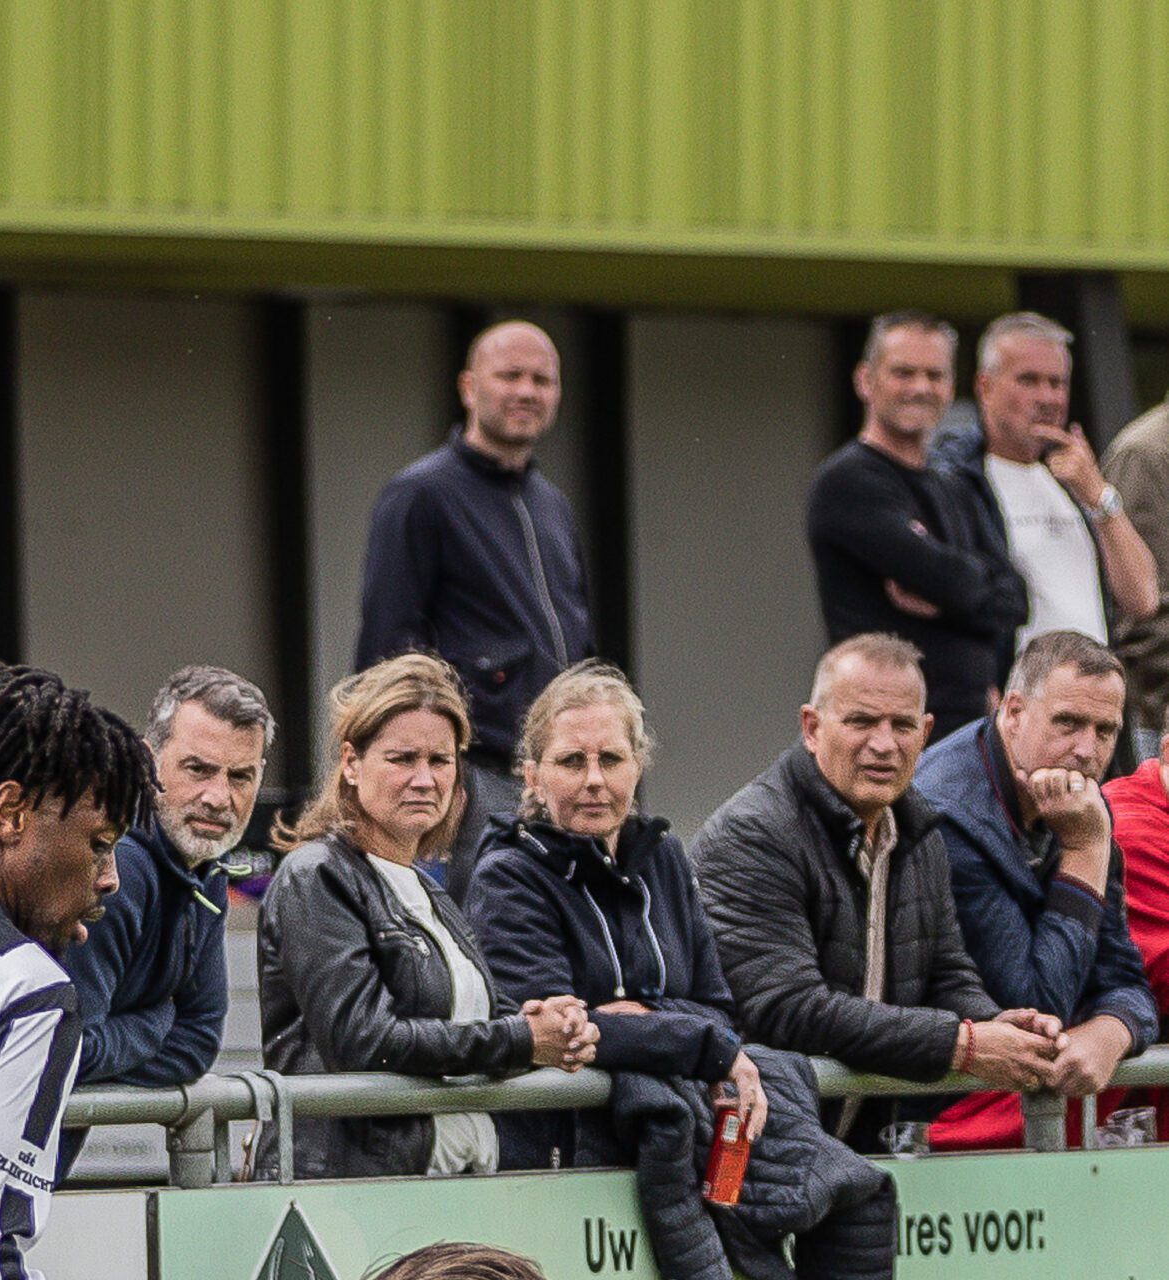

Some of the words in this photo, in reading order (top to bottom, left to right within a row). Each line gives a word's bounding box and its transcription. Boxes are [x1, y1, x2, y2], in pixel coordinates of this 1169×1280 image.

[584, 1217, 637, 1273] Uw
[897, 1212, 953, 1257] res
[964, 1208, 1045, 1253] voor:
